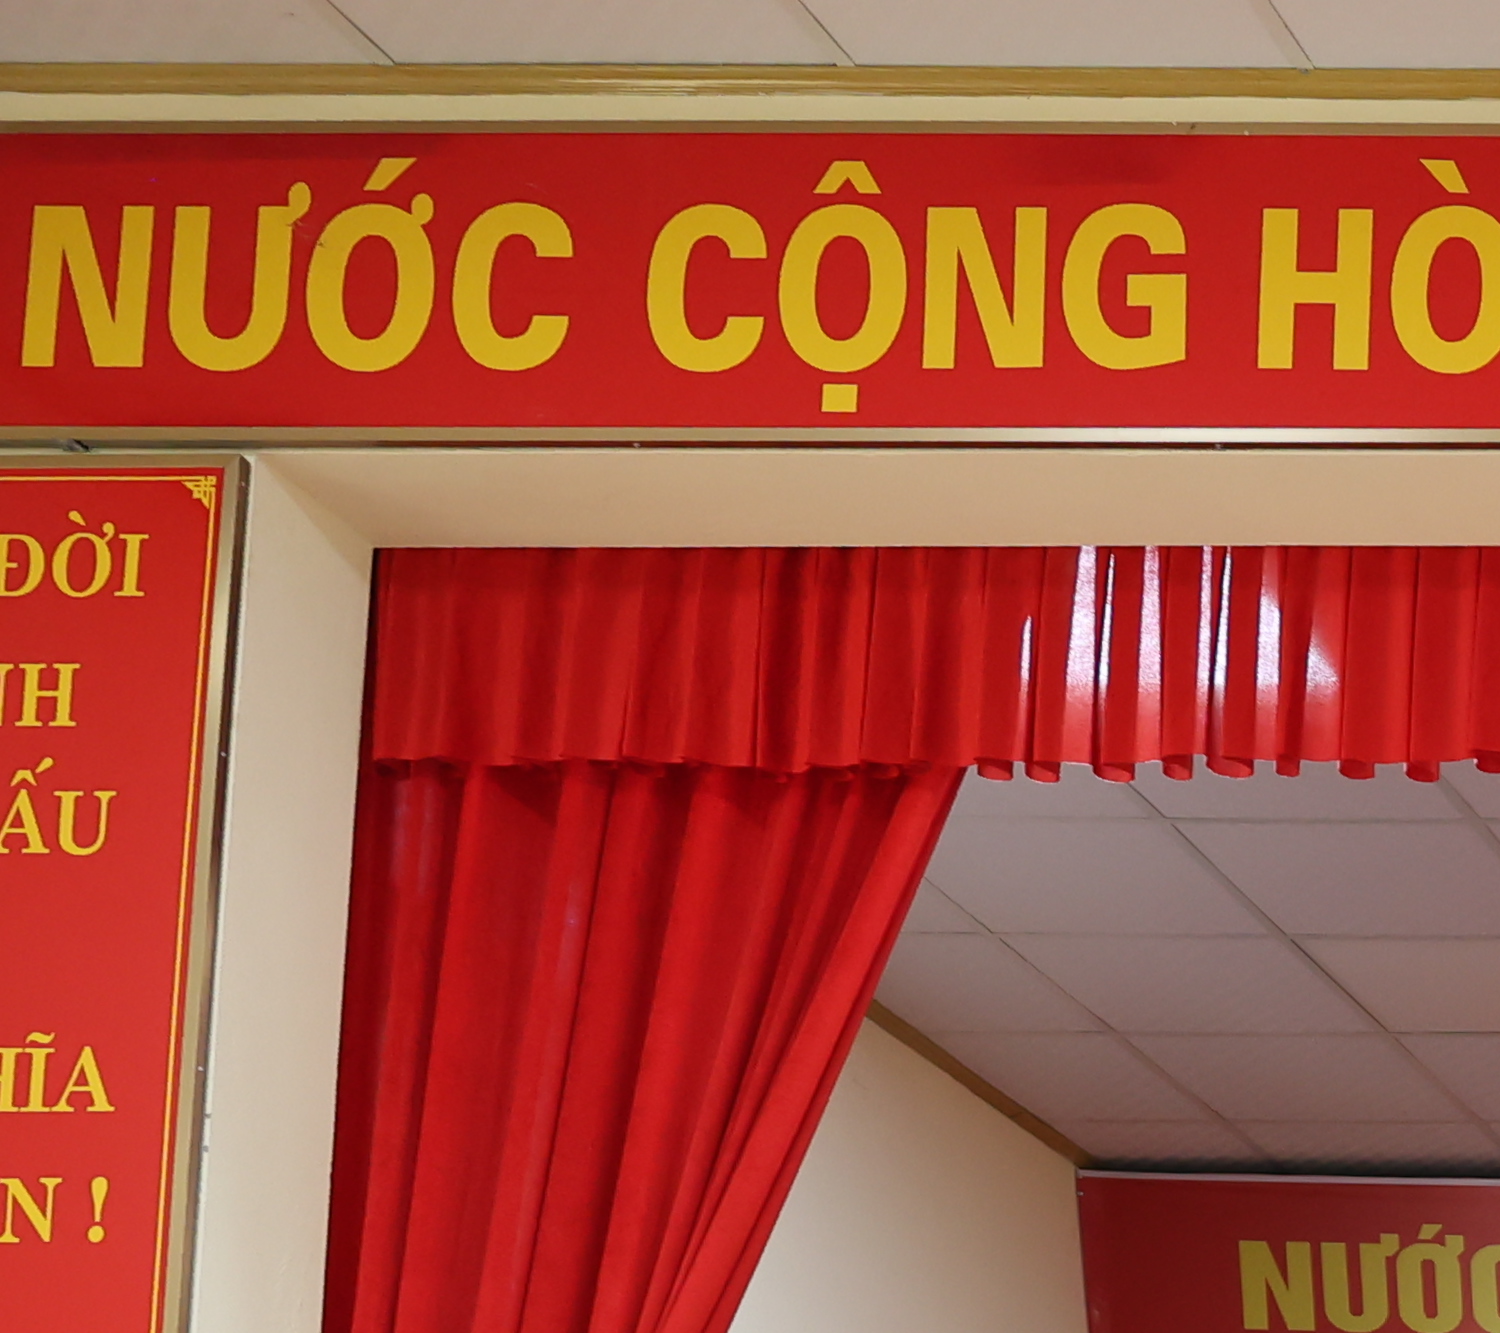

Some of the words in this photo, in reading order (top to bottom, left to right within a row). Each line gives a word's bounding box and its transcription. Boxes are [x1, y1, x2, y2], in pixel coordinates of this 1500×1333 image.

[22, 158, 575, 373] NƯỚC
[647, 161, 1189, 413] CỘNG
[0, 510, 150, 598] ĐỜI
[88, 1176, 110, 1244] !
